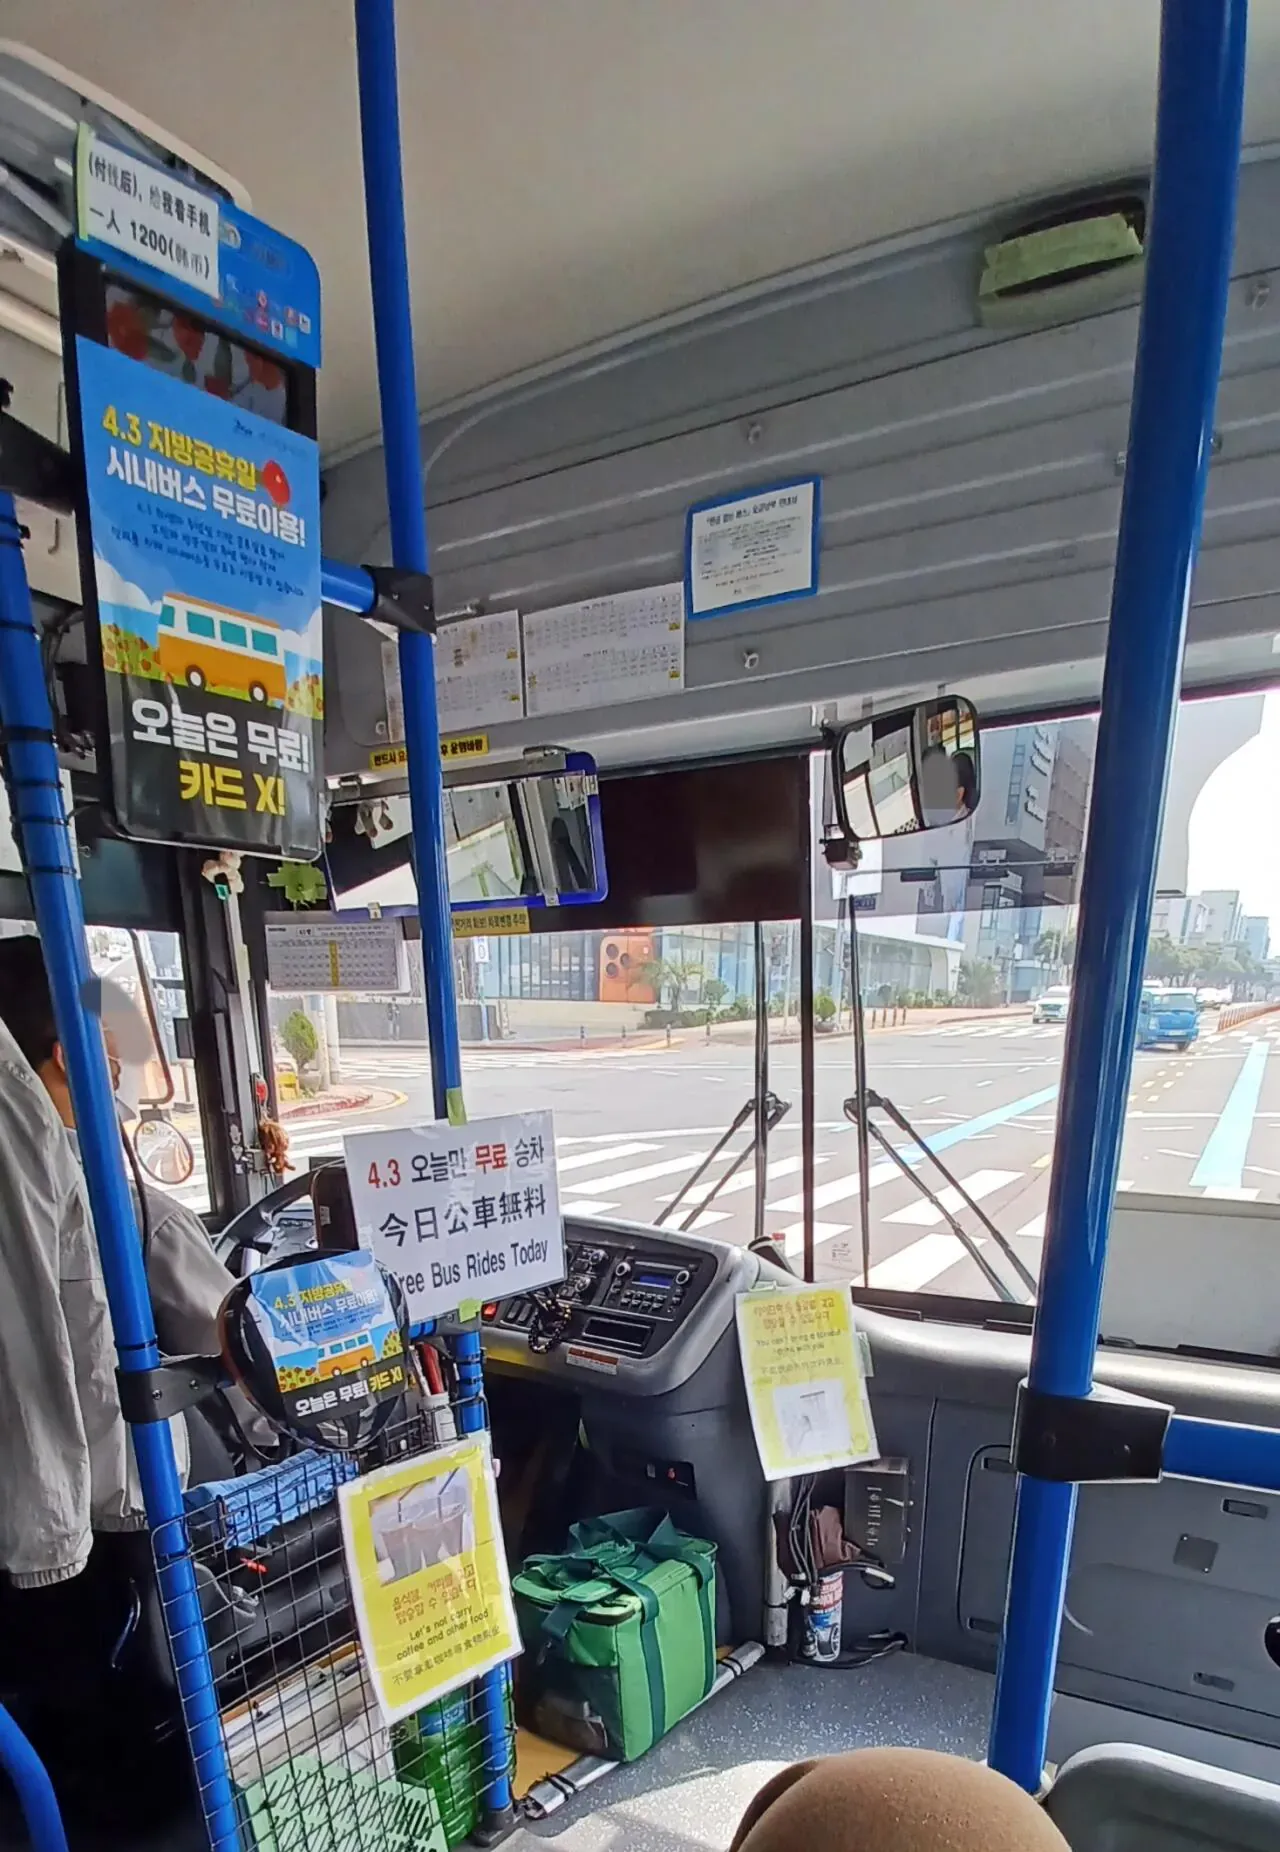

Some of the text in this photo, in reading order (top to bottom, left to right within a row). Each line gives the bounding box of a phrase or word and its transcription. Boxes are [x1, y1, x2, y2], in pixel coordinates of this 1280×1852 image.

[89, 207, 120, 234] 一人
[102, 404, 142, 447] 4.3
[148, 420, 257, 491] 지방공휴일
[106, 446, 207, 511] 시내버스
[212, 485, 306, 547] 무료이용!
[131, 698, 310, 774] 오늘은 무료!
[179, 760, 286, 817] 카드 X!
[367, 1135, 545, 1189] 4.3 오늘만 무료 승차
[379, 1184, 547, 1247] 今日公車無料
[391, 1238, 549, 1297] ree Bus Rides Today
[273, 1293, 296, 1310] 4.3
[280, 1304, 335, 1330] 시내버스
[294, 1389, 338, 1418] 오늘은
[339, 1379, 370, 1403] 무료!
[368, 1373, 392, 1393] 카드
[409, 1605, 472, 1641] Let's not carry
[428, 1597, 438, 1610] 수
[396, 1607, 489, 1661] coffee and other food
